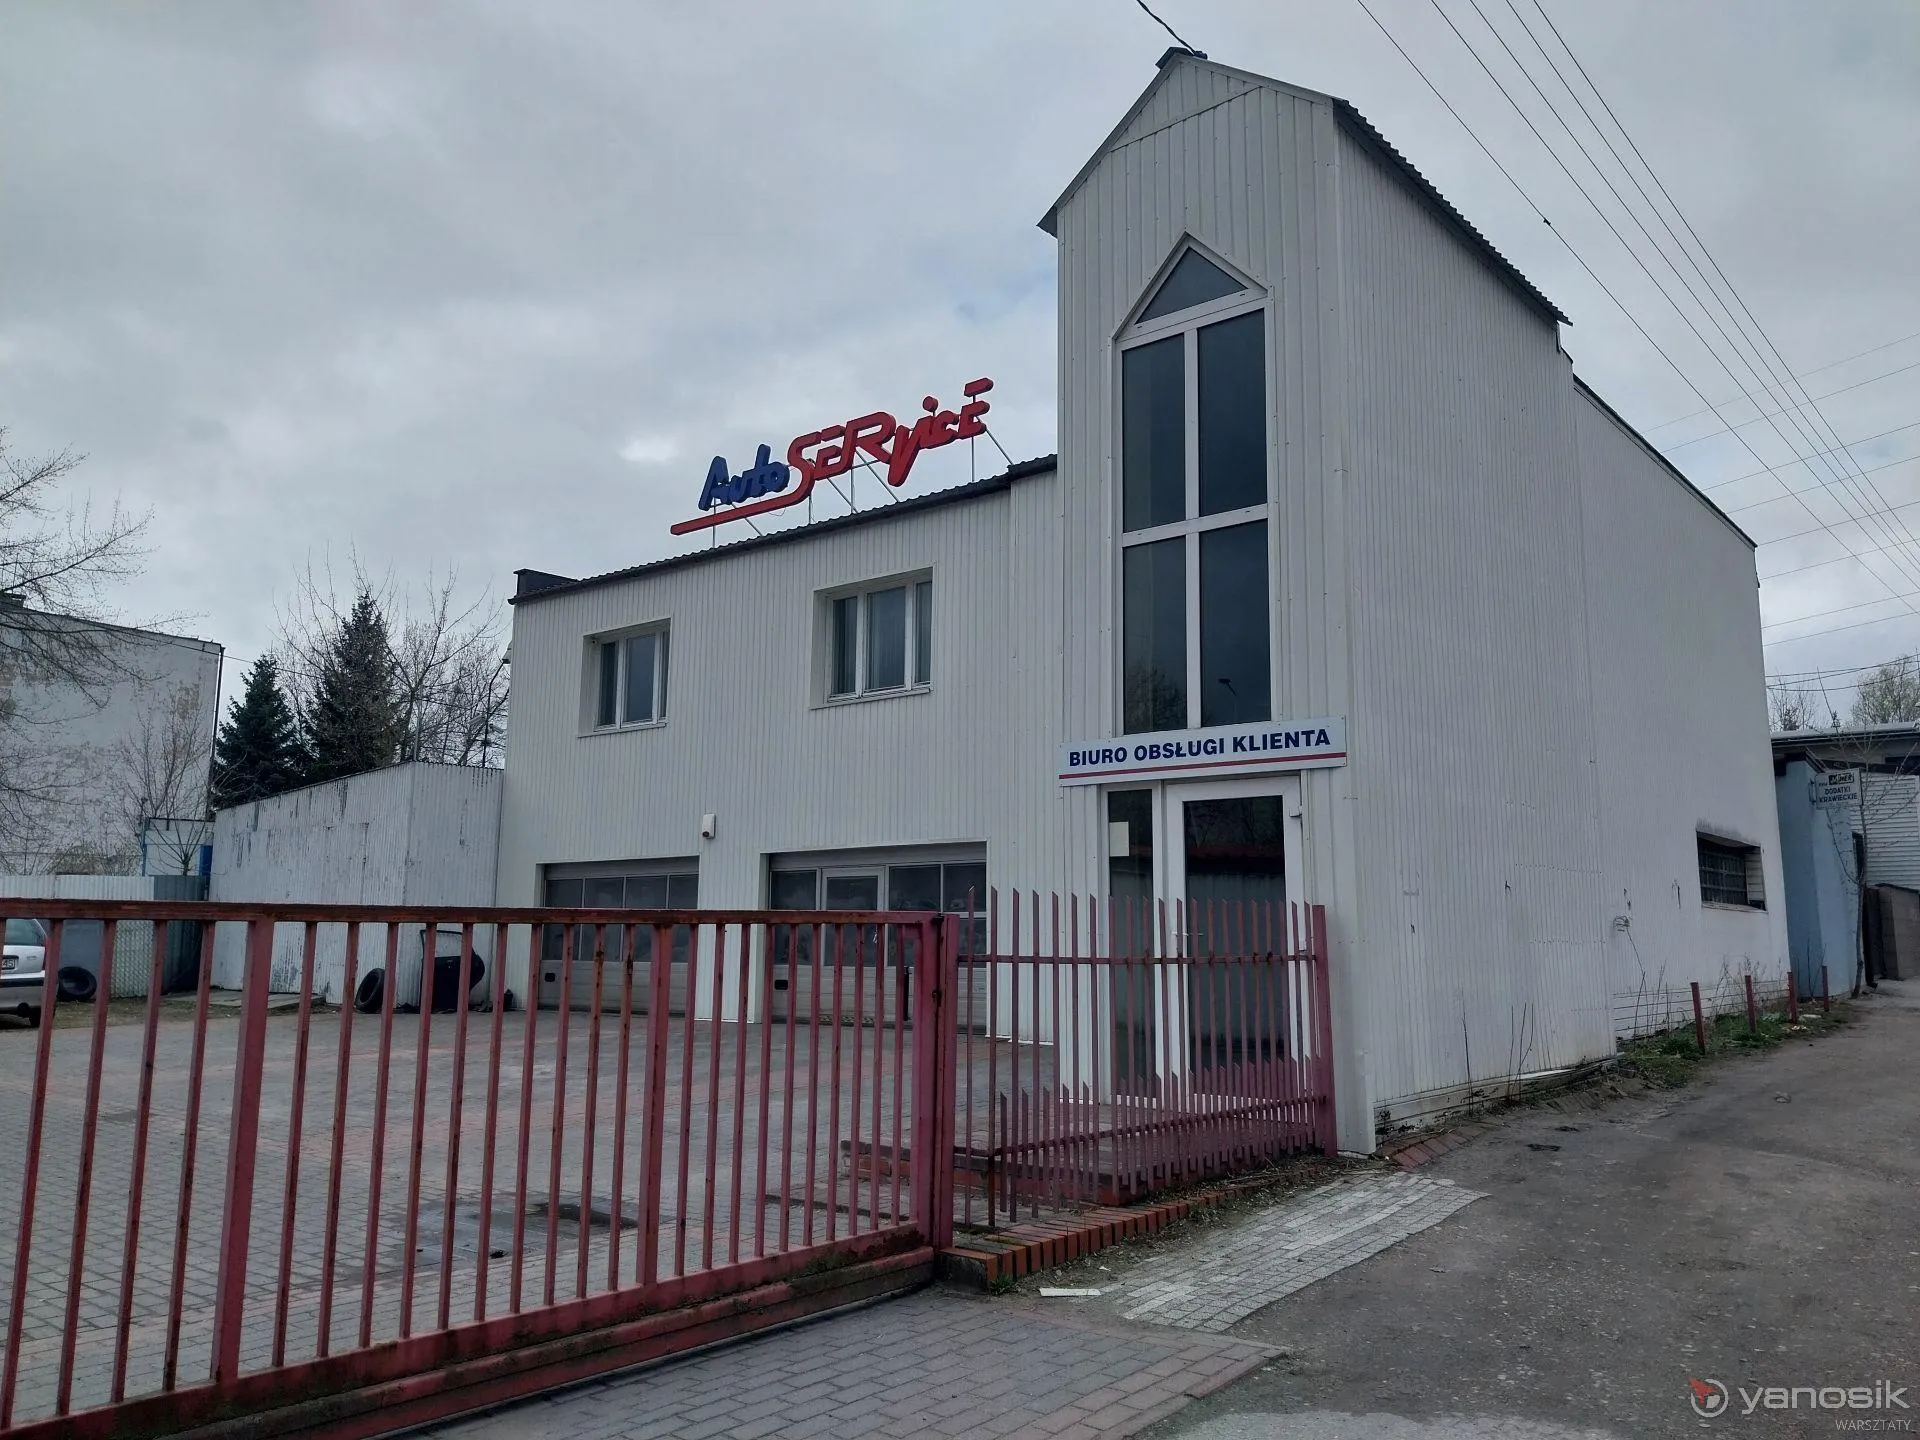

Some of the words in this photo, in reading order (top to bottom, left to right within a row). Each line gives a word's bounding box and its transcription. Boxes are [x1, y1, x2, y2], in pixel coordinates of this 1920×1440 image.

[698, 443, 791, 511] Auto
[1069, 747, 1128, 767] BIURO
[1134, 738, 1225, 761] OBSŁUGI
[1232, 728, 1331, 753] KLIENTA
[1819, 793, 1858, 803] KRAWIECKIE
[1825, 786, 1851, 795] DODATKI
